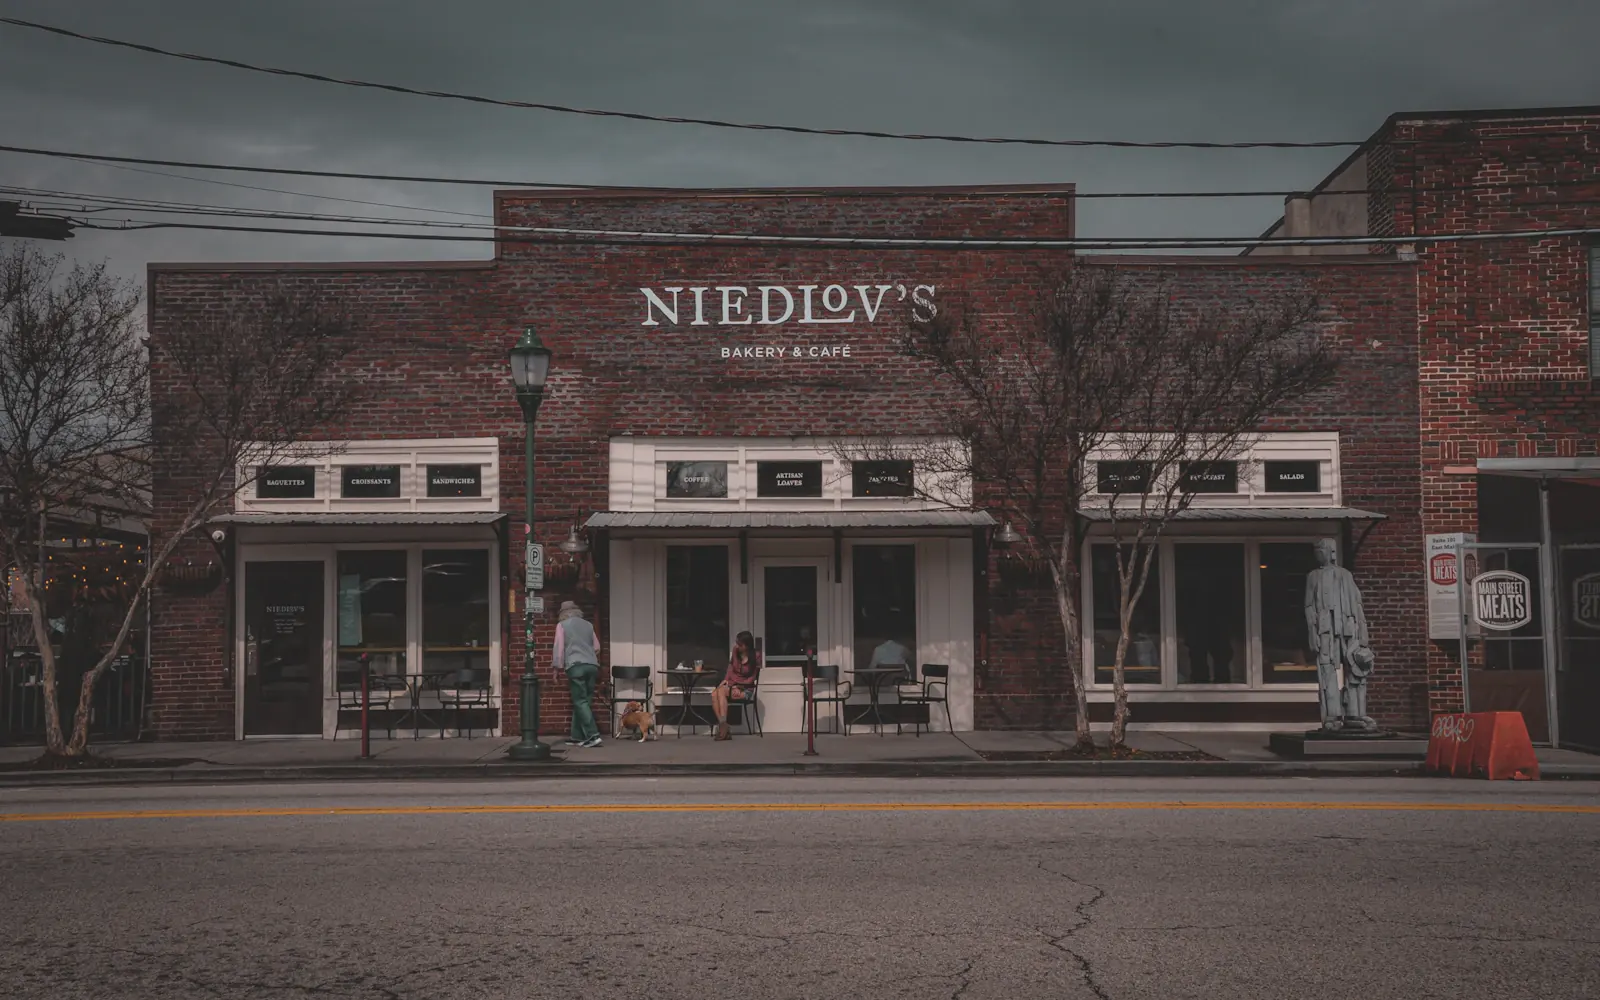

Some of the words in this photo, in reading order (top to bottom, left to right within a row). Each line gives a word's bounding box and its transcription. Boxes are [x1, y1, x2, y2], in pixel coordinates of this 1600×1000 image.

[639, 284, 938, 326] NIEDLOV'S
[721, 347, 786, 358] BAKERY
[792, 346, 802, 357] &
[809, 344, 851, 357] CAFÉ
[432, 477, 475, 485] SANDWICHES
[1279, 473, 1305, 481] SALADS
[1478, 581, 1498, 594] MAIN
[1498, 581, 1523, 594] STREET
[1479, 594, 1525, 619] MEATS
